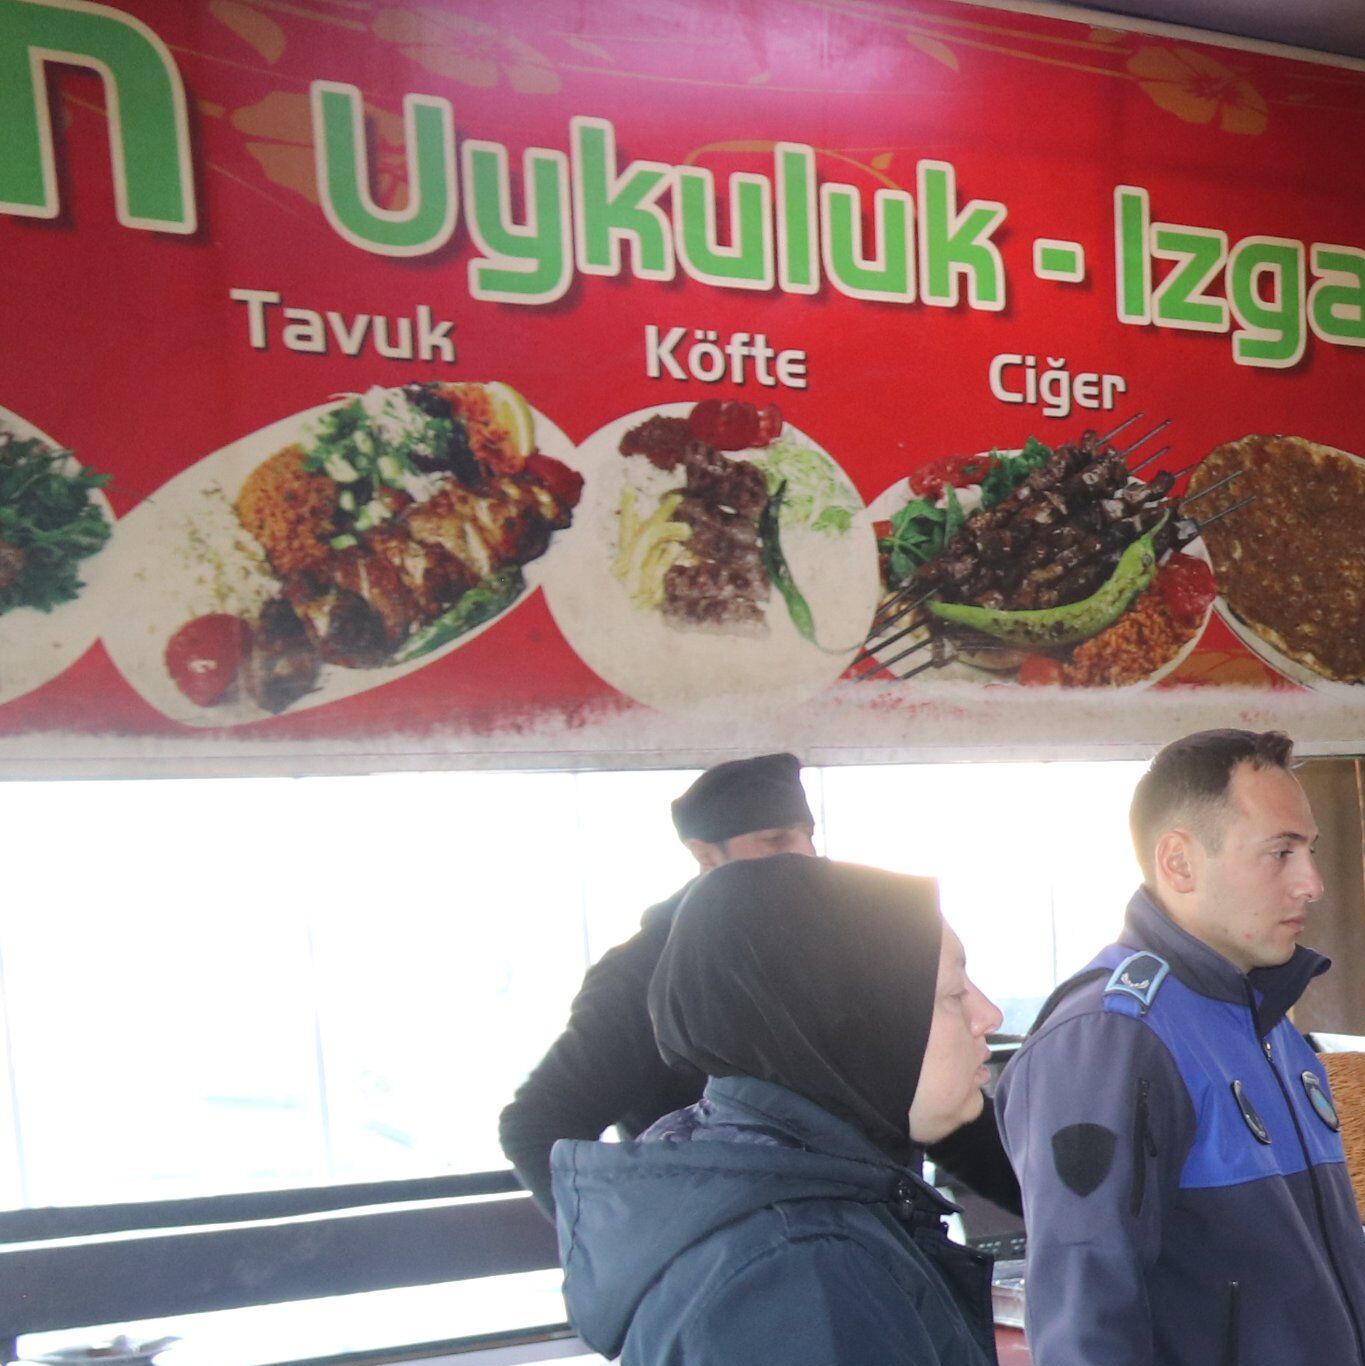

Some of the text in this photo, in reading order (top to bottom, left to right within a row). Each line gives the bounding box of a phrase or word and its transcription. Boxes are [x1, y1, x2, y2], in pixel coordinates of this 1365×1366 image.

[310, 79, 1006, 311] Uykuluk
[230, 288, 456, 363] Tavuk
[644, 325, 807, 389] Köfte
[988, 353, 1127, 417] Ciğer
